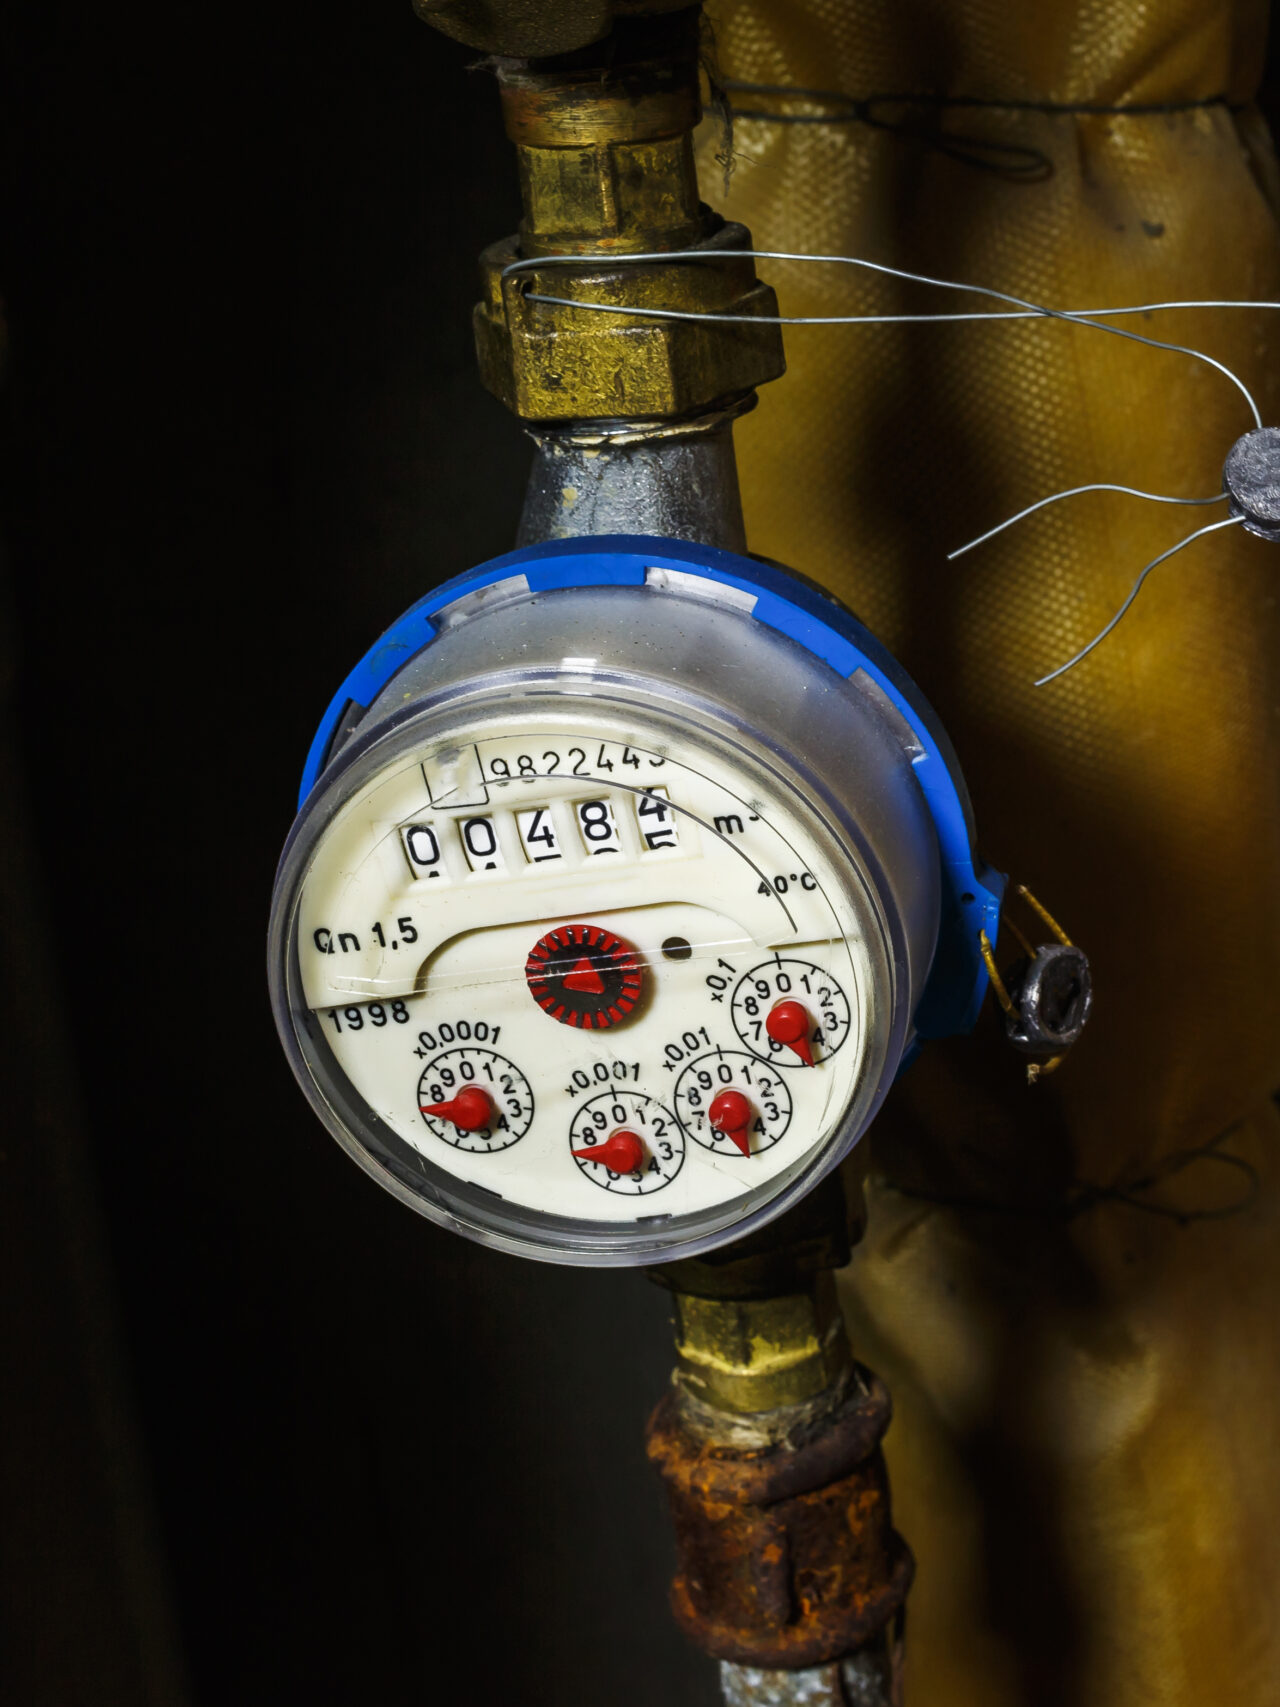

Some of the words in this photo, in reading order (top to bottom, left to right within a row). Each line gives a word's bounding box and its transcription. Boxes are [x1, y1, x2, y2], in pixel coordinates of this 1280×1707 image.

[313, 927, 361, 954] Qn
[371, 916, 418, 951] 1,5
[755, 980, 770, 999] 9
[776, 973, 791, 992] 0
[800, 974, 811, 994] 1
[745, 996, 759, 1015] 8
[328, 1000, 410, 1033] 1998
[824, 1012, 838, 1031] 3
[749, 1021, 762, 1041] 7
[812, 1027, 825, 1046] 4
[440, 1068, 455, 1087] 9
[460, 1061, 475, 1081] 0
[482, 1062, 494, 1082] 1
[698, 1071, 713, 1090] 9
[717, 1064, 732, 1083] 0
[741, 1066, 751, 1084] 1
[430, 1084, 445, 1103] 8
[500, 1074, 516, 1094] 2
[758, 1078, 774, 1097] 2
[688, 1087, 701, 1105] 8
[507, 1098, 522, 1118] 3
[765, 1102, 780, 1121] 3
[582, 1126, 596, 1145] 8
[592, 1111, 607, 1130] 9
[612, 1105, 627, 1123] 0
[652, 1118, 666, 1137] 2
[659, 1142, 673, 1160] 3
[753, 1117, 766, 1135] 4
